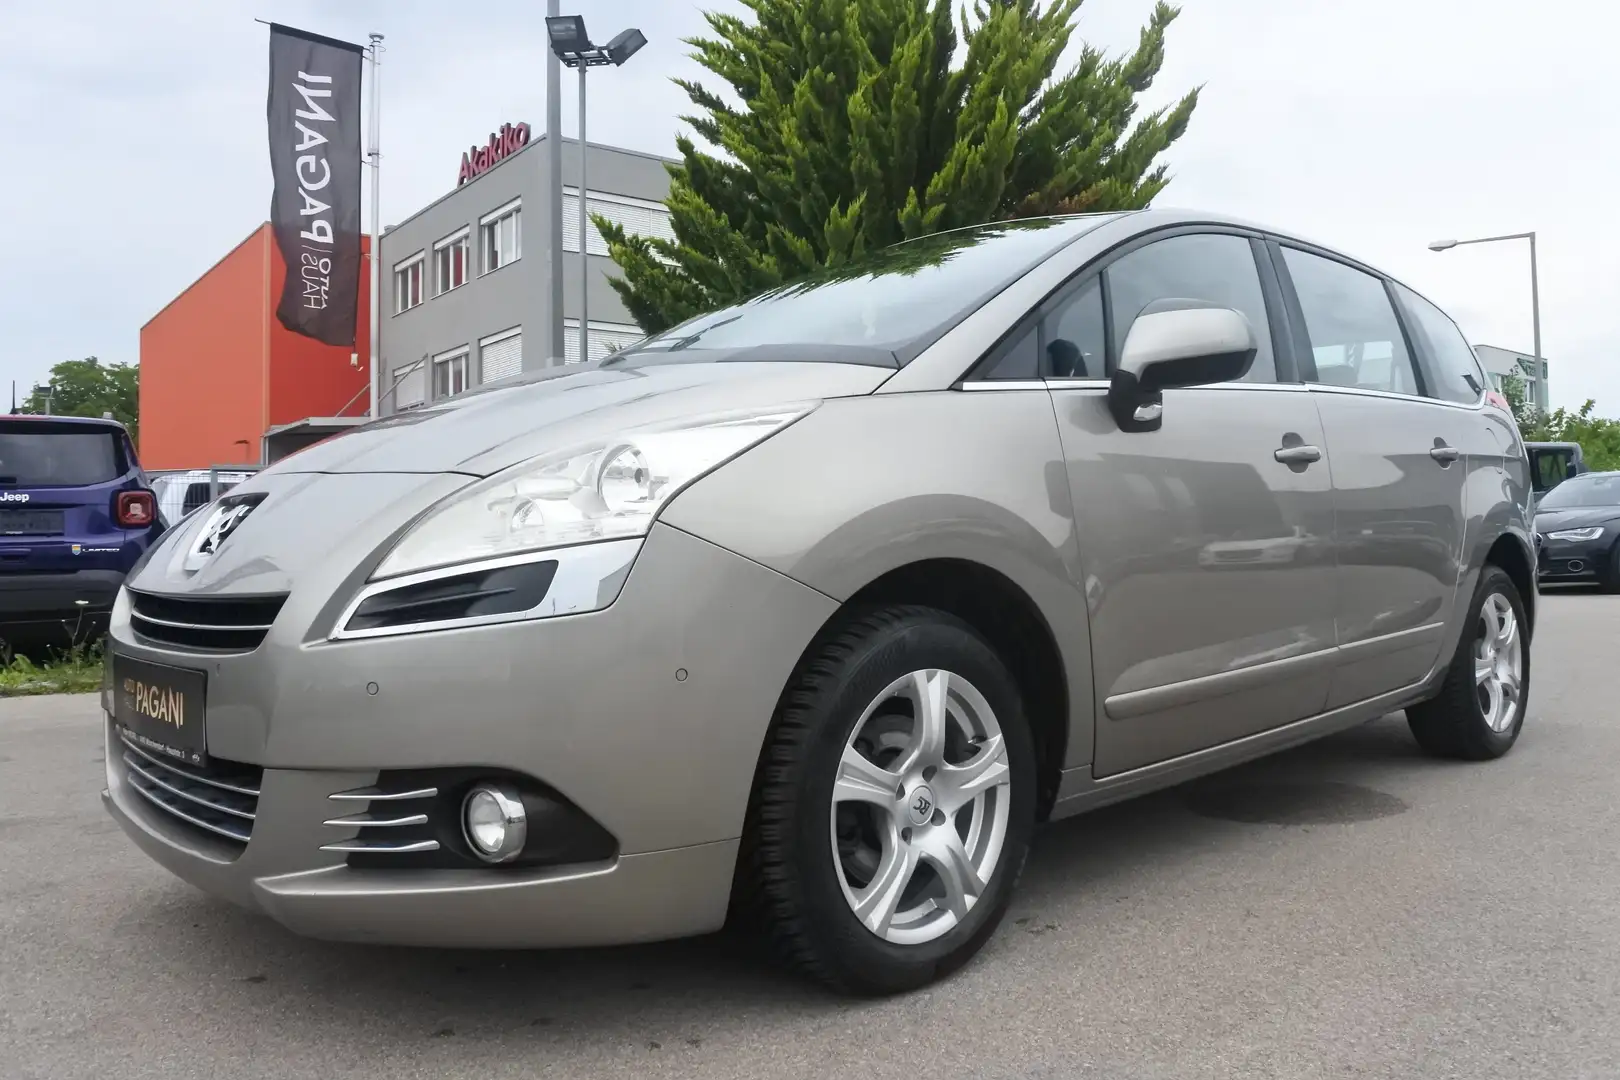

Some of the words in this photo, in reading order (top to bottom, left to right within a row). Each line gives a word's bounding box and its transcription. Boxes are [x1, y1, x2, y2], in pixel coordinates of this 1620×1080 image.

[457, 121, 531, 188] Akakiko
[0, 492, 30, 503] Jeep
[136, 681, 184, 729] PAGANI
